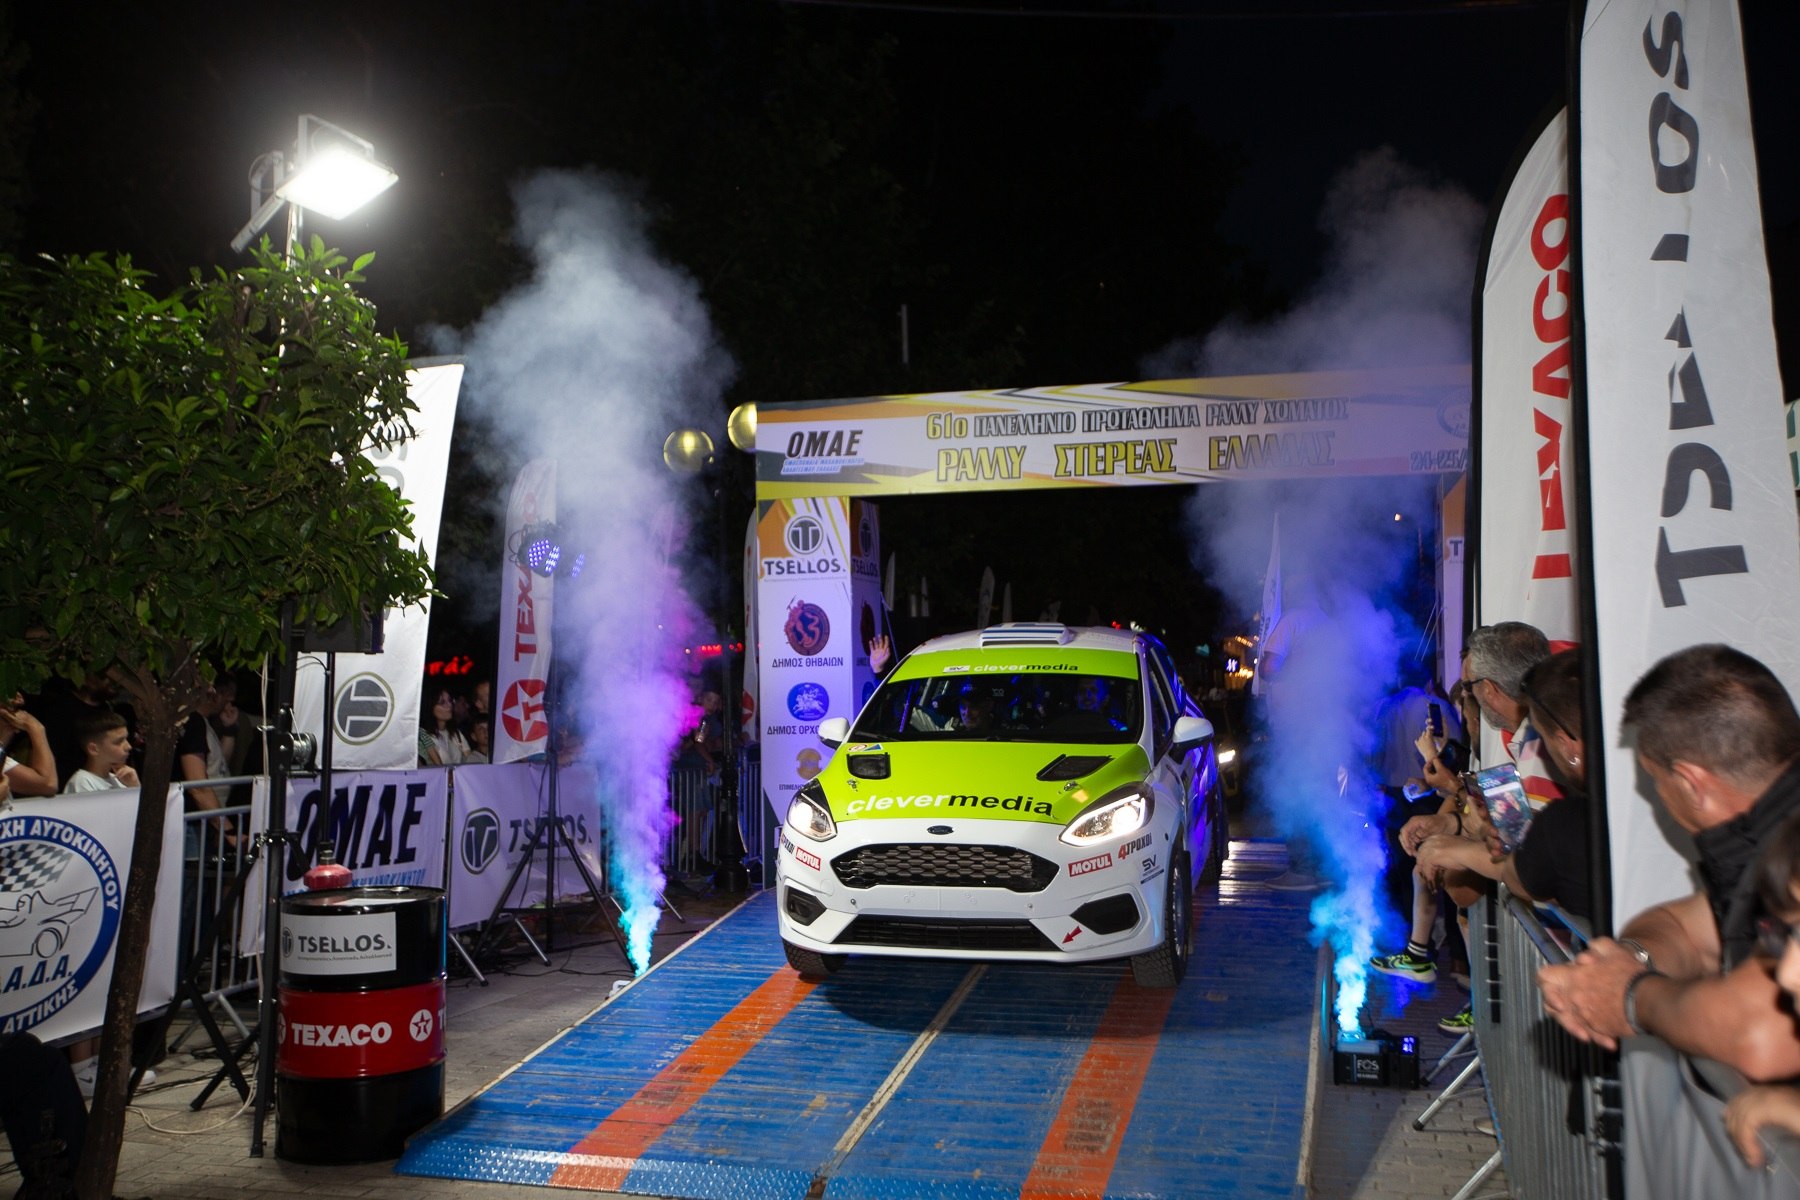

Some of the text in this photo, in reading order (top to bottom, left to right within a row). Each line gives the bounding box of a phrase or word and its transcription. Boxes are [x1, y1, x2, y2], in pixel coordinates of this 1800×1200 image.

[974, 411, 1076, 437] ΠΑΝΕΛΛΗΝΙΟ
[1082, 404, 1200, 432] ΠΡΩΤΑΘΛΗΜΑ
[1206, 402, 1259, 427] ΡΑΛΛΥ
[1264, 398, 1350, 424] ΧΩΜΑΤΟΣ
[937, 445, 1026, 481] ΡΑΛΛΥ
[1054, 438, 1177, 477] ΣΤΕΡΕΑΣ
[772, 657, 803, 668] ΔΗΜΟΣ
[805, 657, 844, 667] ΘΗΒΑΙΩΝ
[974, 664, 1079, 672] clevermedia
[767, 725, 797, 735] ΔΗΜΟΣ
[847, 794, 1054, 817] clevermedia
[0, 819, 119, 911] ΧΗ ΑΥΤΟΚΙΝΗΤΟΥ
[797, 849, 820, 869] MOTUL
[1071, 856, 1111, 875] MOTUL
[1142, 854, 1157, 872] SV
[2, 979, 78, 1034] ΑΤΤΙΚΗΣ
[291, 1021, 393, 1047] TEXACO
